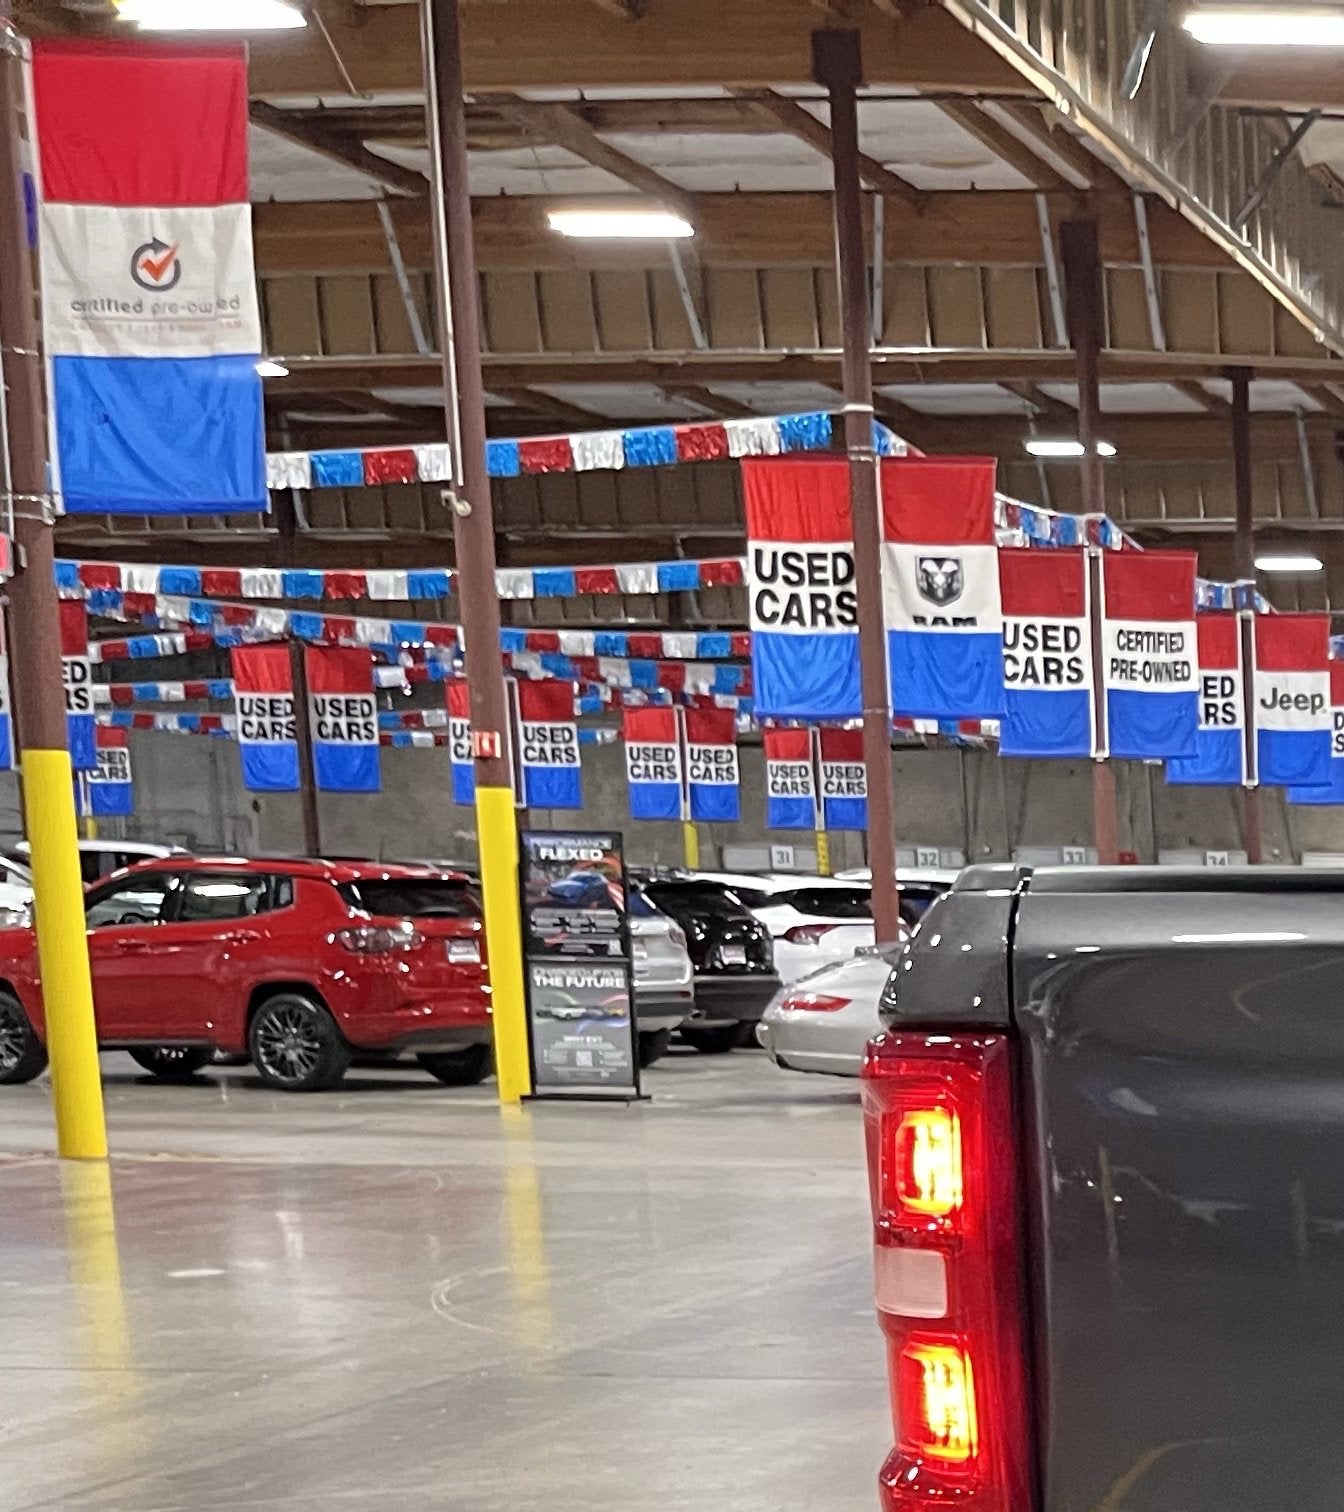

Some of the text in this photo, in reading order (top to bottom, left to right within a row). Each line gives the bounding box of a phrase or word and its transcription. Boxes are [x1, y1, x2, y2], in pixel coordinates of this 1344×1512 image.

[754, 548, 855, 588] USED
[755, 589, 858, 628] CARS
[912, 614, 978, 627] RAM
[1002, 621, 1082, 654] USED
[1116, 628, 1185, 654] CERTIFIED
[1003, 654, 1085, 685] CARS
[1110, 657, 1192, 684] PRE-OWNED
[1203, 676, 1236, 699] ED
[239, 697, 295, 718] USED
[314, 697, 373, 718] USED
[1260, 687, 1325, 715] Jeep
[1200, 702, 1238, 726] RS
[241, 719, 296, 740] CARS
[317, 720, 375, 741] CARS
[523, 726, 574, 745] USED
[97, 750, 128, 765] SED
[523, 745, 578, 765] CARS
[629, 746, 676, 763] USED
[689, 747, 734, 763] USED
[629, 764, 678, 781] CARS
[689, 765, 736, 781] CARS
[769, 764, 810, 780] USED
[823, 765, 864, 780] USED
[770, 781, 811, 796] CARS
[823, 781, 867, 796] CARS
[920, 851, 938, 867] 32
[533, 975, 626, 989] THE FUTURE
